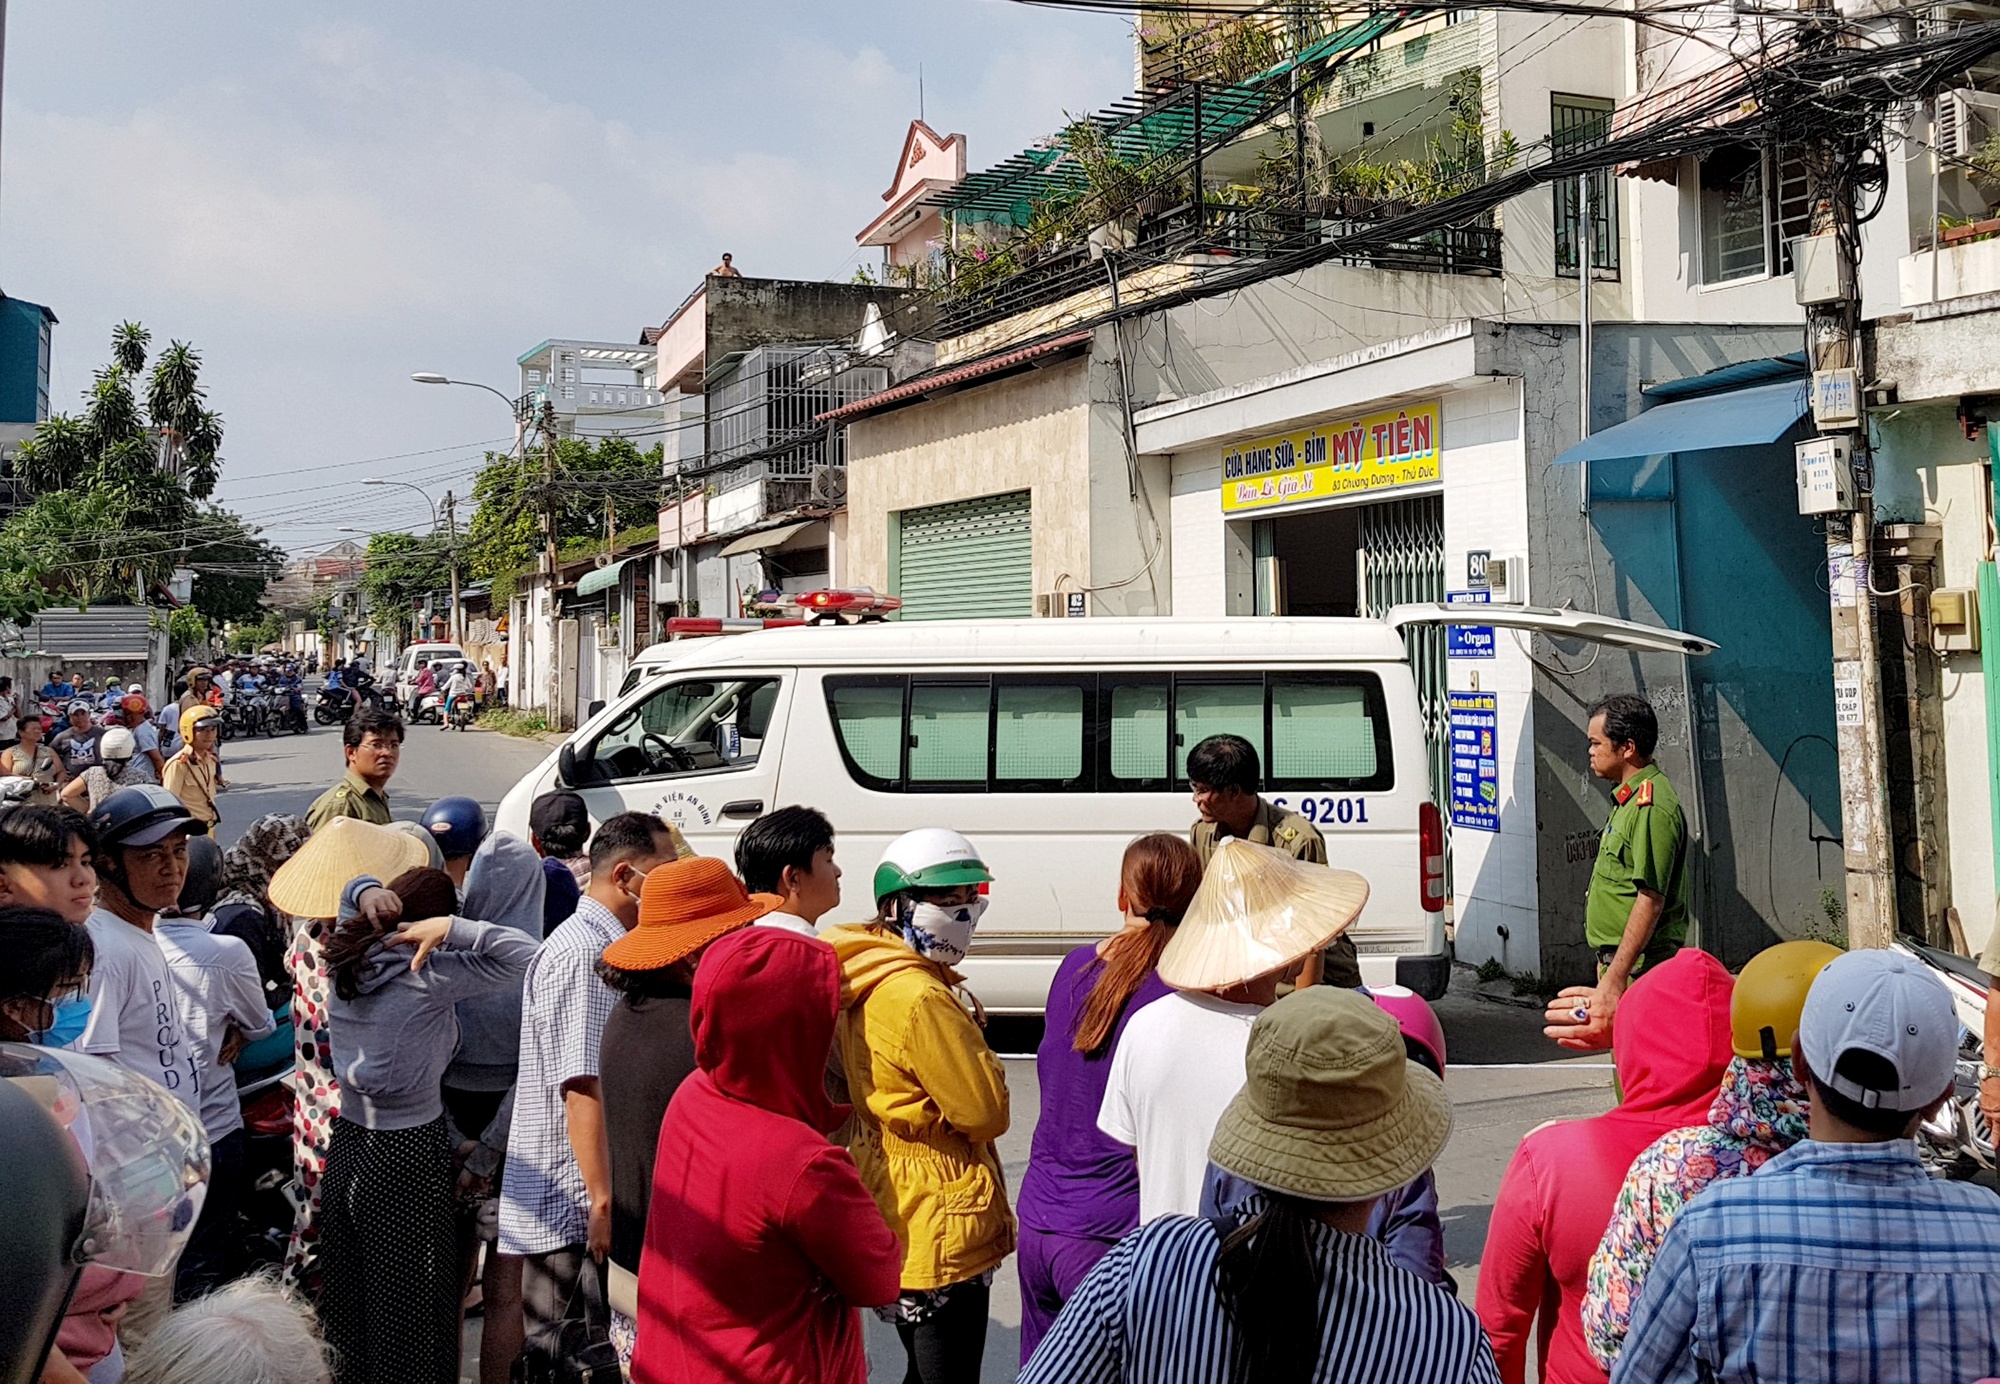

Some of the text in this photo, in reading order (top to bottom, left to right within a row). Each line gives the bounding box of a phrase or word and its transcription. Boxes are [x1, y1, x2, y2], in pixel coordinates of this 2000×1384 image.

[1245, 446, 1272, 475] HÀNG
[1274, 439, 1295, 470] SỮA
[1332, 421, 1365, 470] MỸ
[1470, 554, 1488, 577] 80
[1071, 594, 1083, 606] 82
[1464, 631, 1491, 647] Organ
[662, 790, 685, 804] VIỆN
[686, 794, 699, 806] AN
[152, 979, 180, 1090] PROUD
